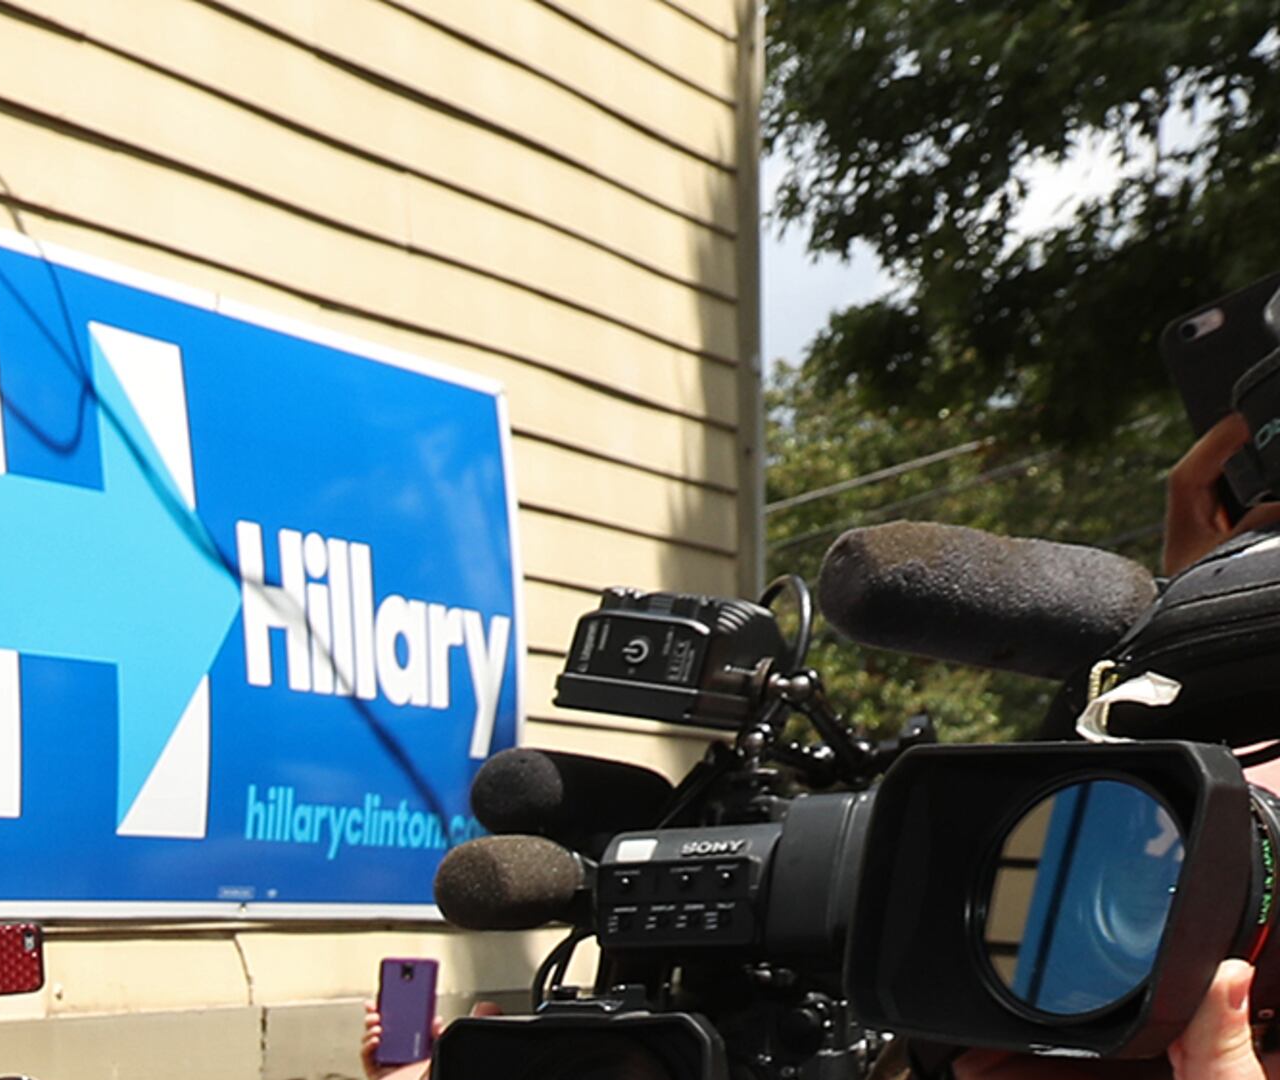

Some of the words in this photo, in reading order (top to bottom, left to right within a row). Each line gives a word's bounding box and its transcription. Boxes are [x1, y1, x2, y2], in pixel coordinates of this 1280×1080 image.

[235, 520, 510, 760] Hillary
[244, 784, 489, 860] hillaryclinton.co
[681, 839, 746, 856] SONY
